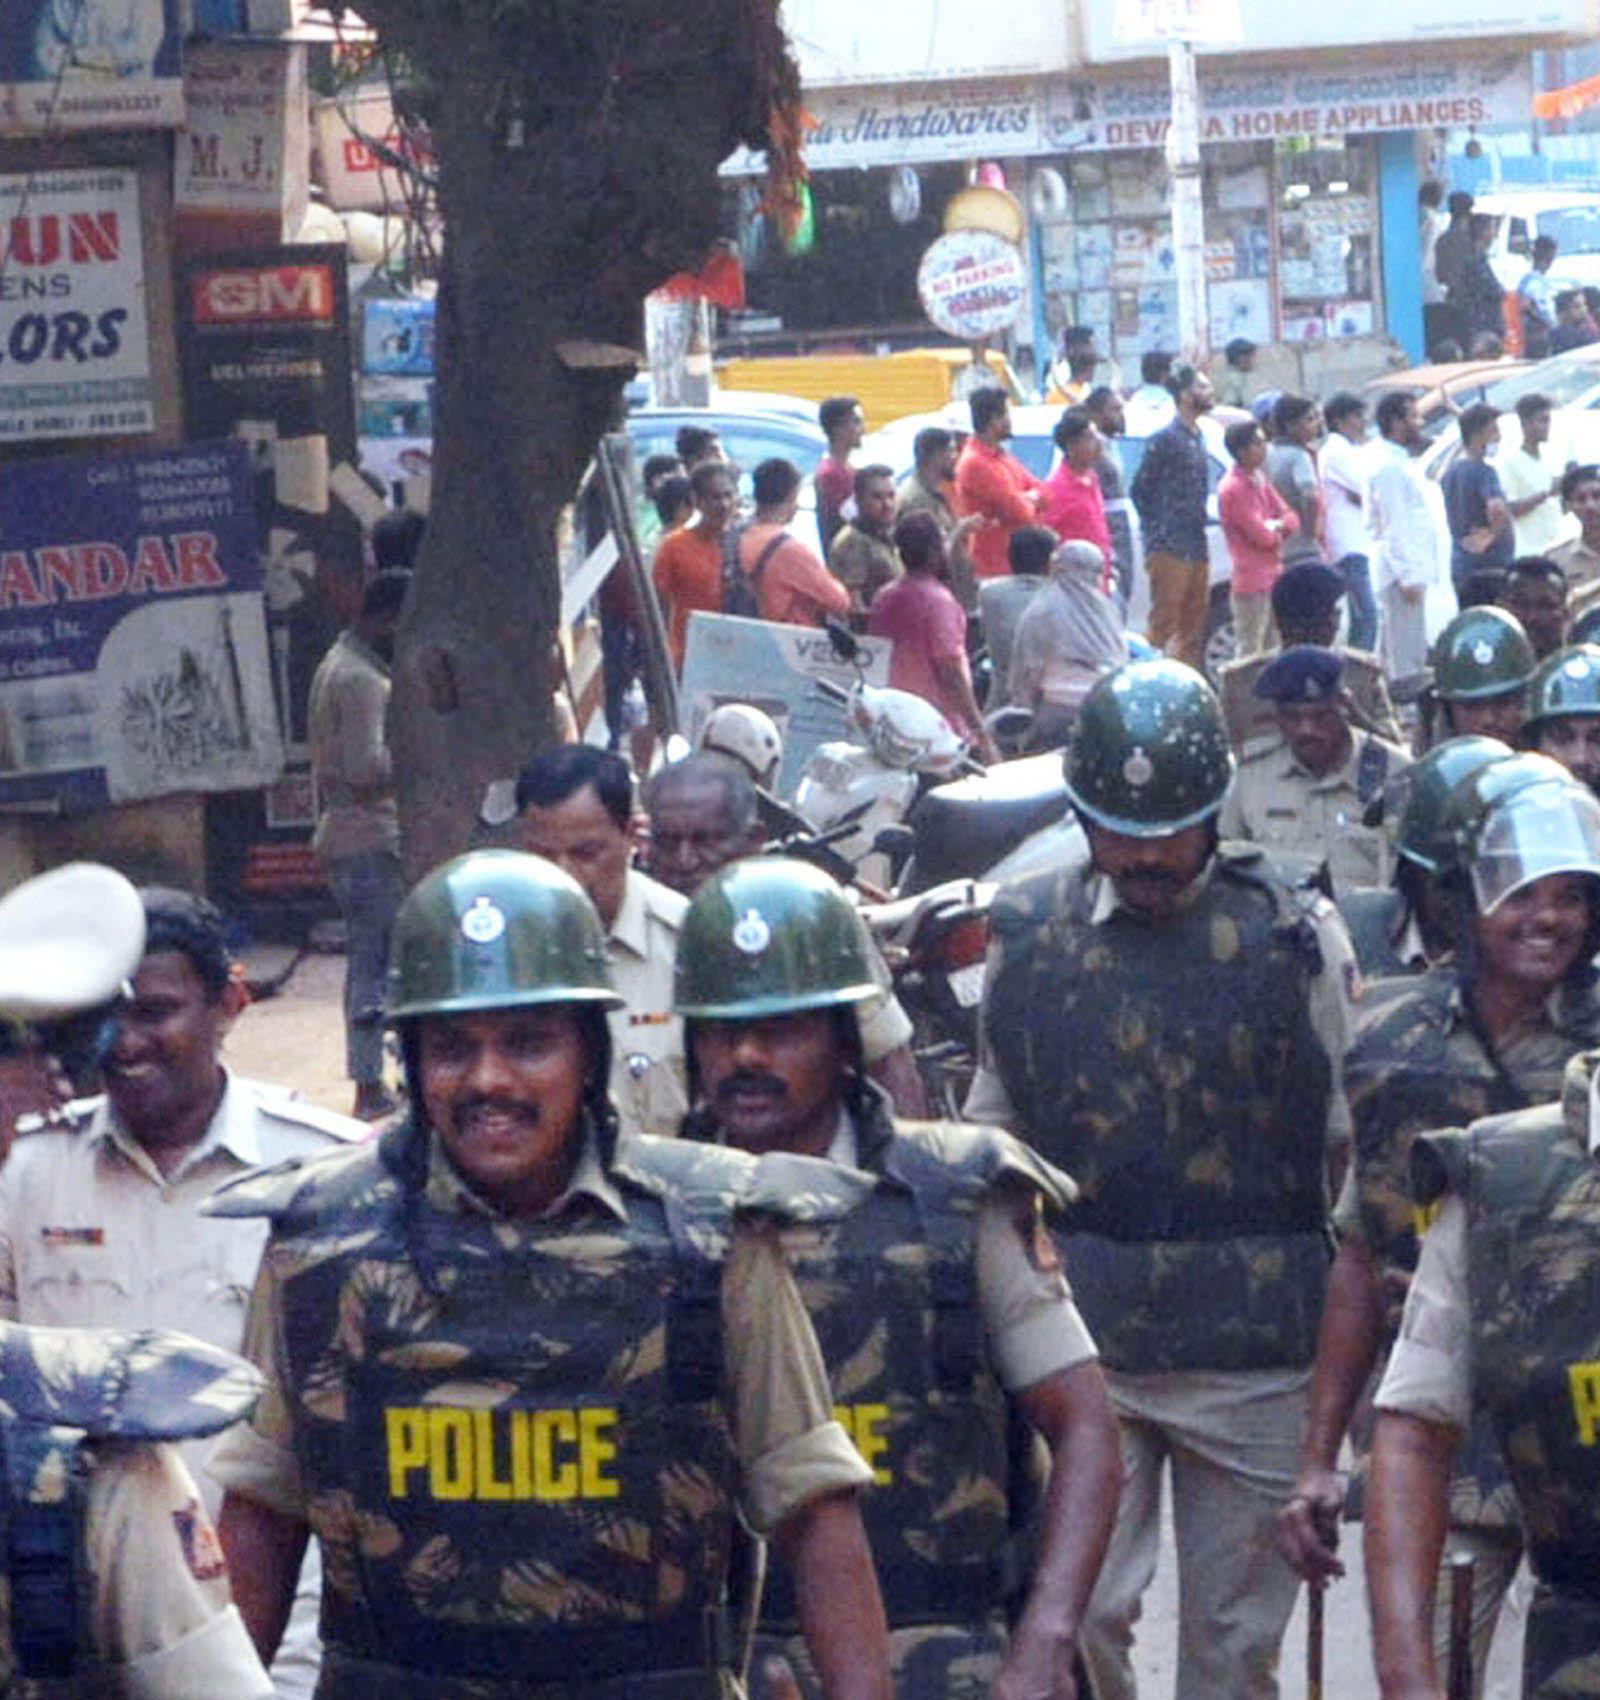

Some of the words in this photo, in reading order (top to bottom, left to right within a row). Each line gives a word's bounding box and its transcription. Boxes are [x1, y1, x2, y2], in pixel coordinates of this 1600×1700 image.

[842, 105, 1031, 144] Hardwares
[1106, 117, 1225, 146] DEVA
[1233, 110, 1318, 137] HOME
[384, 1406, 621, 1499] POLICE
